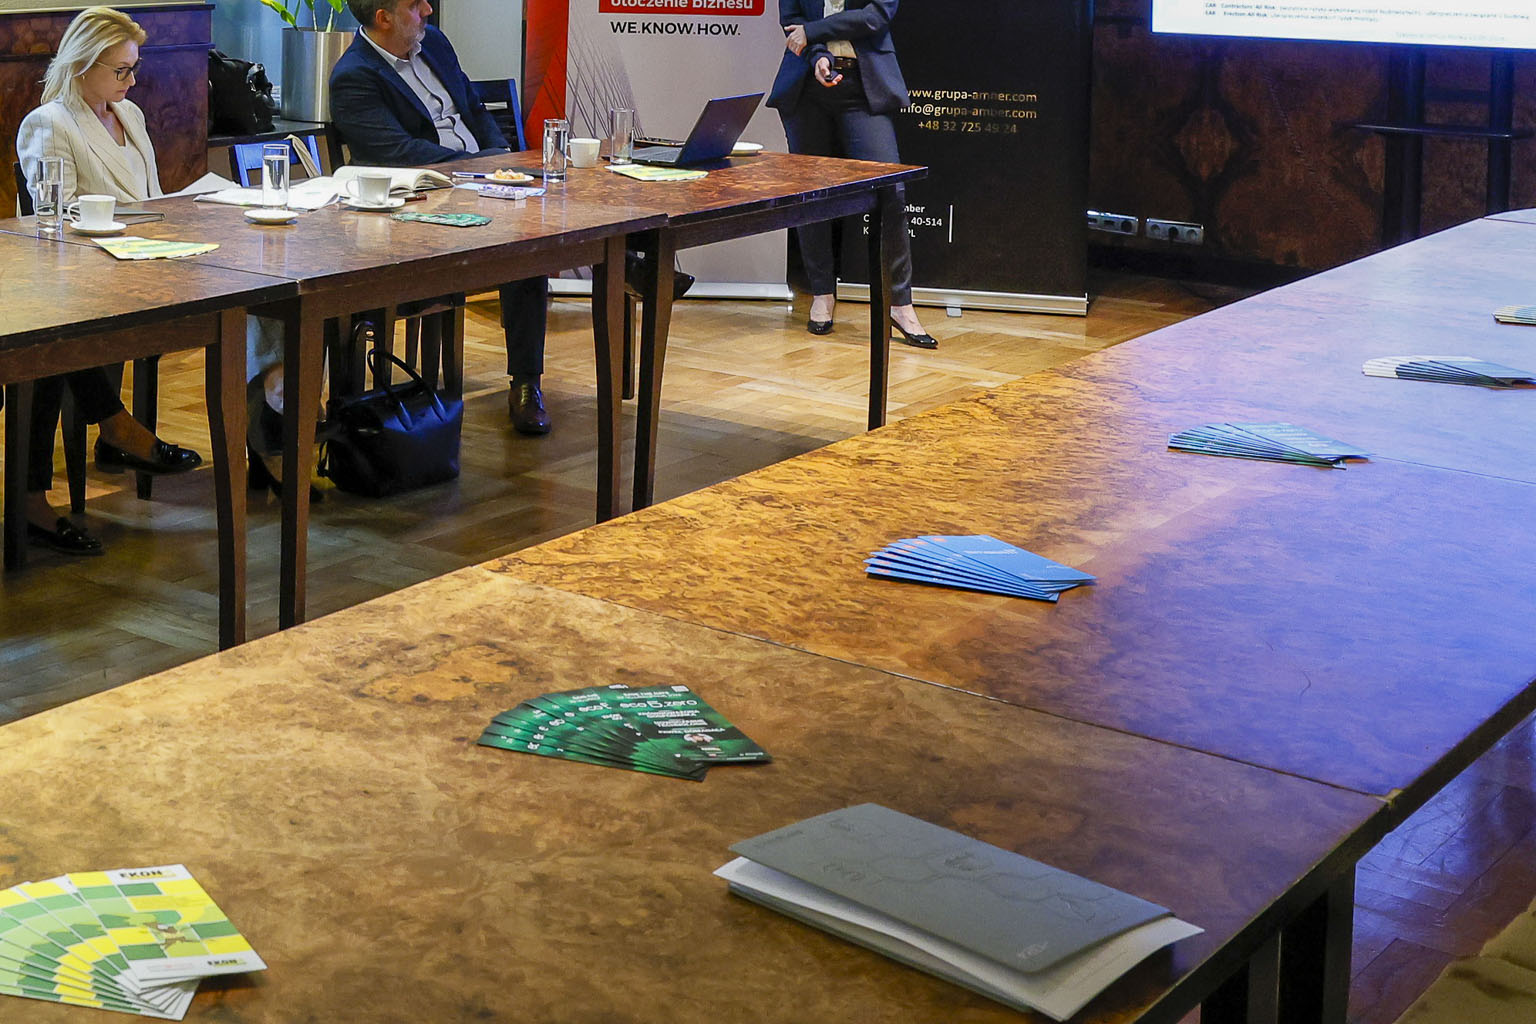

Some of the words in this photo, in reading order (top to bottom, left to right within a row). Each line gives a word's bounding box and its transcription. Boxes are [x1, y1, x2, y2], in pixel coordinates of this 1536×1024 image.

[610, 21, 741, 36] WE.KNOW.HOW.
[918, 120, 940, 131] +48
[943, 121, 957, 131] 32
[961, 121, 982, 133] 725
[910, 216, 942, 227] 40-514
